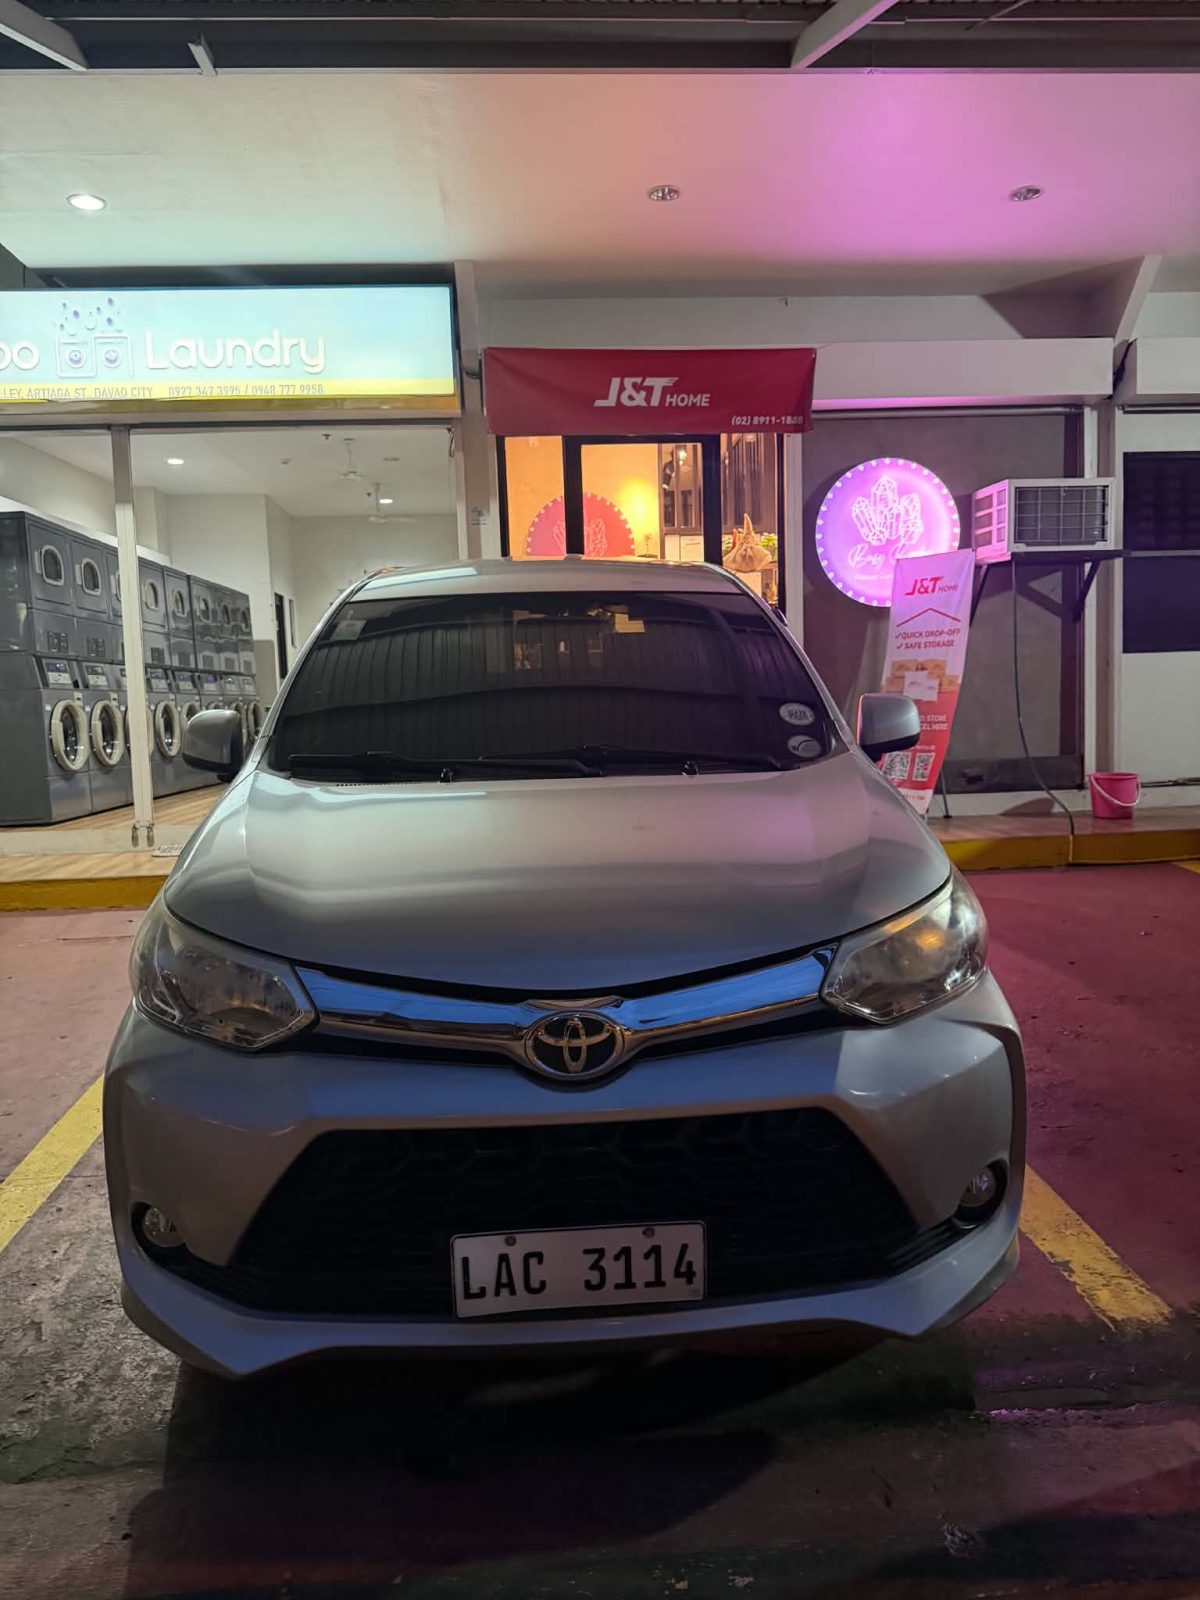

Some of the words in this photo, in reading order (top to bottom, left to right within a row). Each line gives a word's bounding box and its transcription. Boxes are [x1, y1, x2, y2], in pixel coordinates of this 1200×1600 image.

[145, 327, 326, 375] Laundry
[27, 387, 70, 399] ARTIAGA
[94, 387, 127, 399] DAVAO
[131, 386, 153, 399] CITY
[279, 384, 296, 395] 777
[593, 377, 679, 407] J&T
[665, 394, 710, 407] HOME
[731, 415, 751, 425] (02)
[905, 576, 944, 596] J&T
[938, 584, 958, 593] HOME
[901, 630, 923, 640] QUICK
[925, 628, 961, 638] DROP-OFF
[905, 642, 922, 650] SAFE
[923, 640, 955, 649] STORAGE
[461, 1251, 547, 1300] LAC
[582, 1243, 697, 1291] 3114
